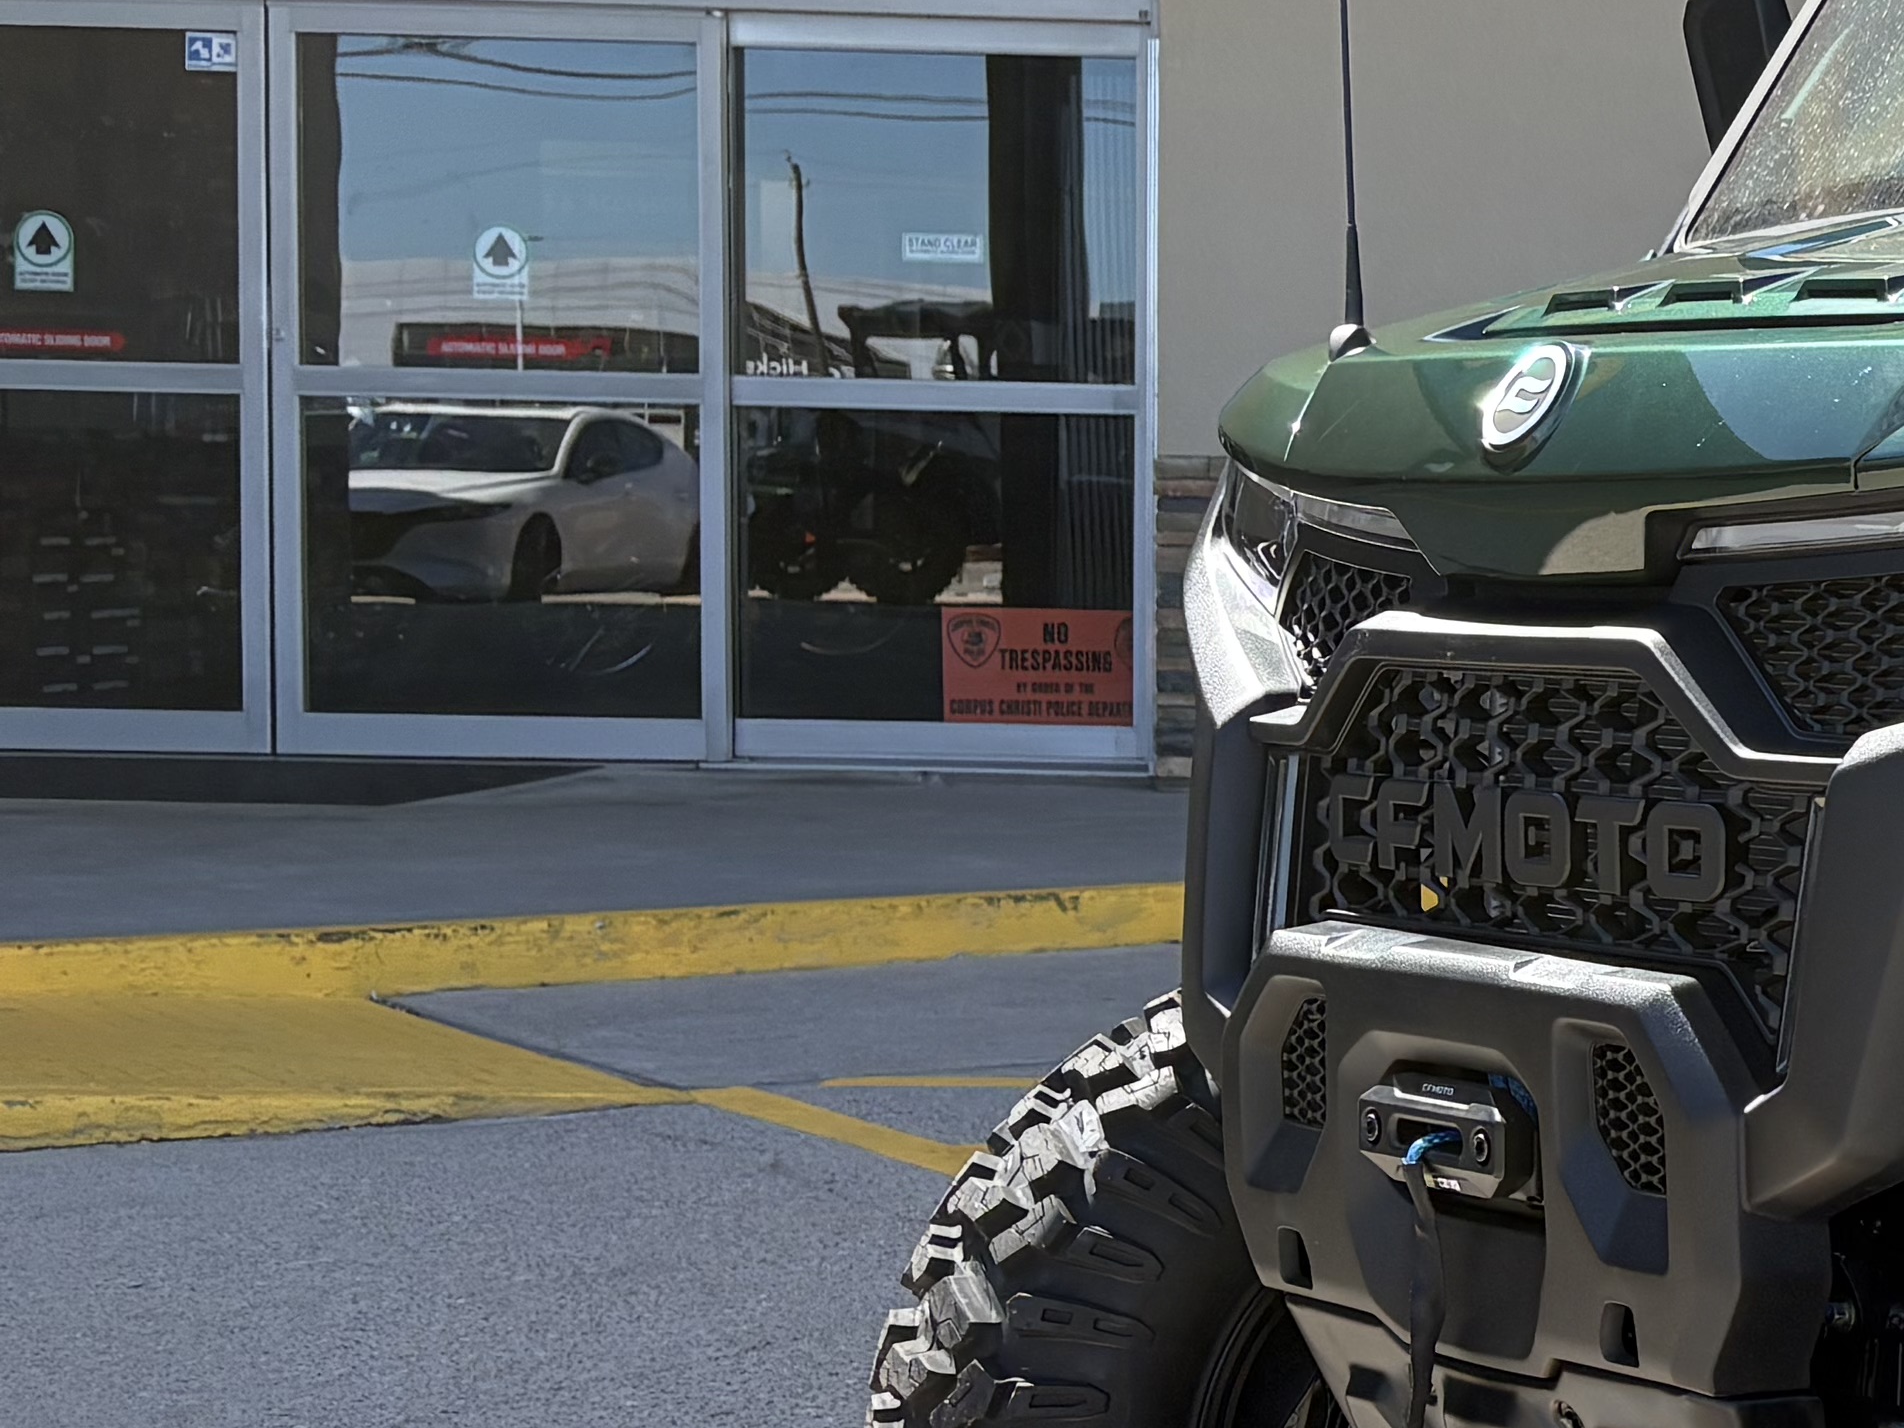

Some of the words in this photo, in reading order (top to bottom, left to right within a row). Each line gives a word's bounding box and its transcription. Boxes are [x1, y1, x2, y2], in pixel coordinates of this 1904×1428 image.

[1043, 622, 1069, 645] NO
[999, 649, 1112, 673] TRESPASSING
[950, 699, 994, 716] CORPUS
[998, 700, 1043, 717] CHRISTI
[1046, 701, 1084, 717] POLICE
[1328, 775, 1727, 903] CFMOTO
